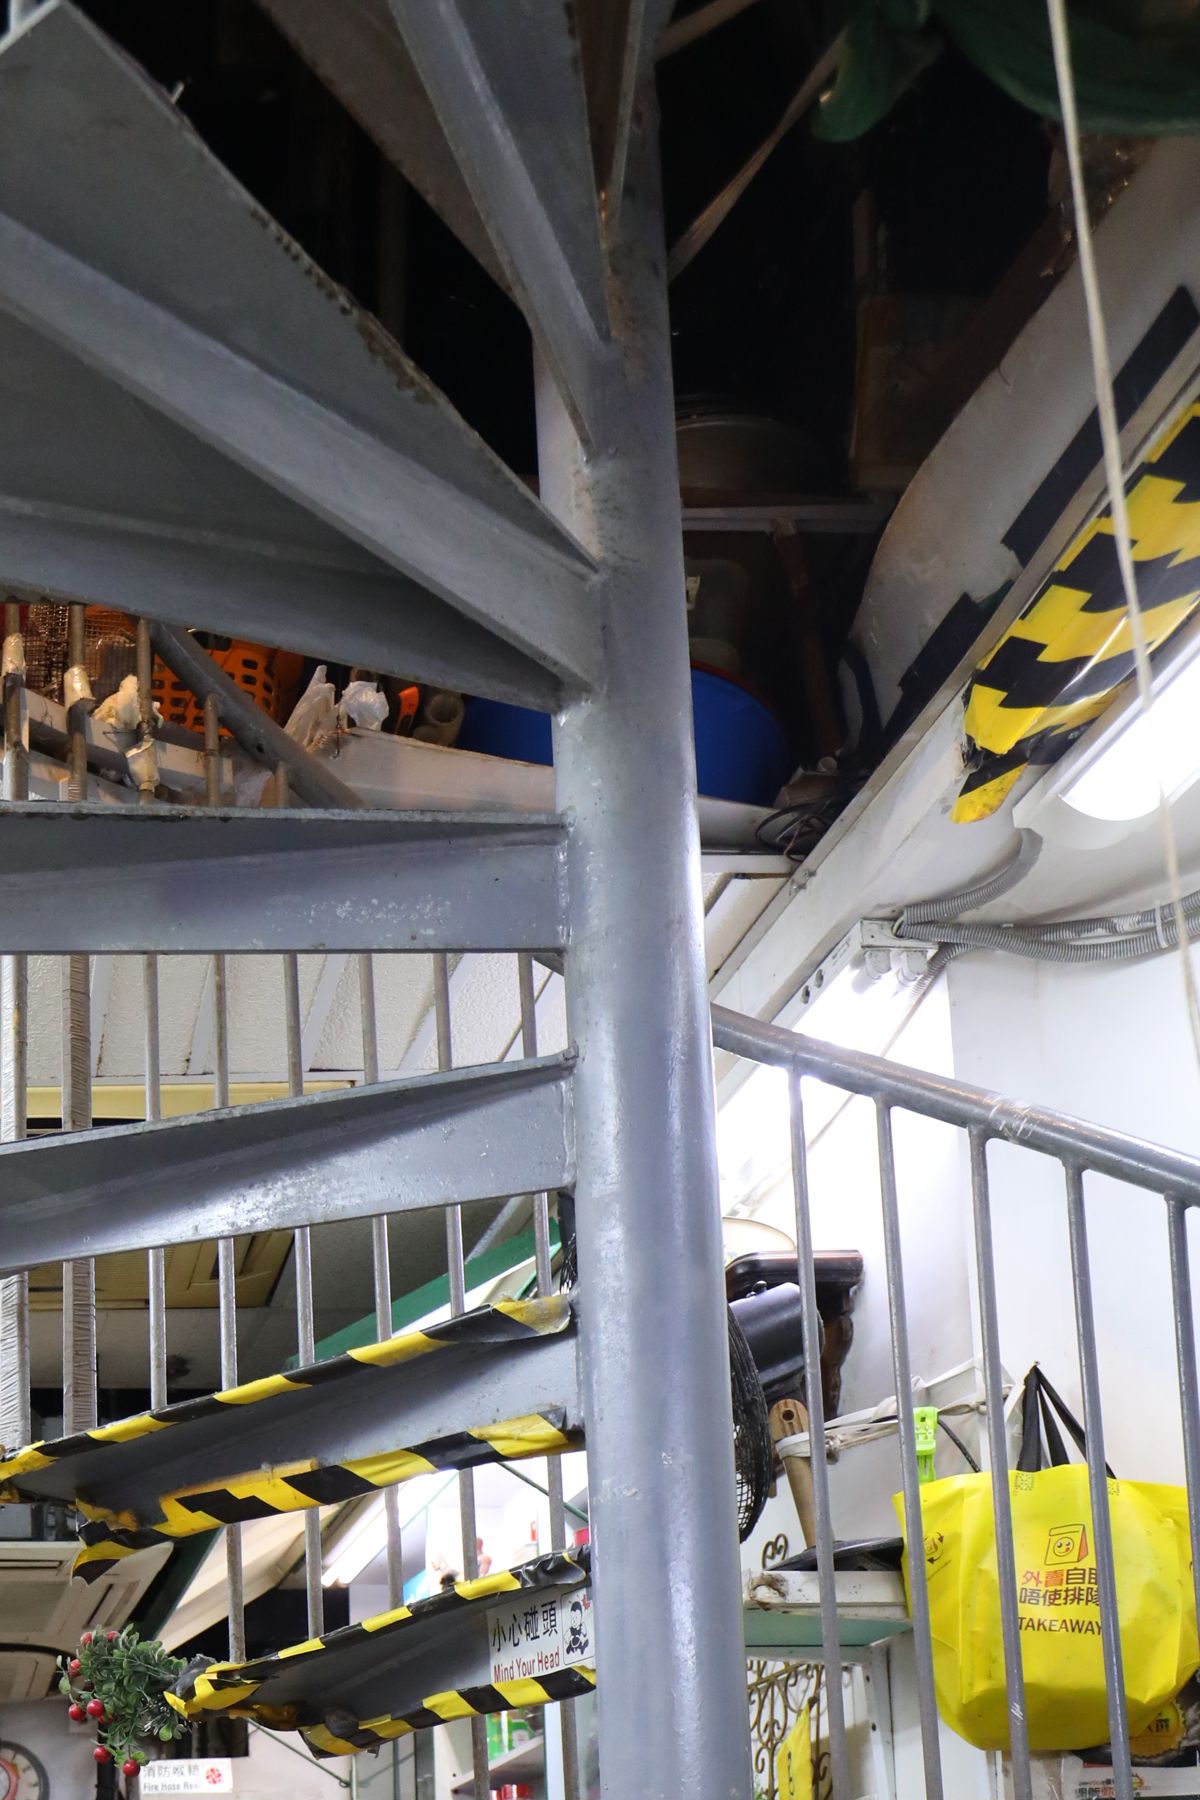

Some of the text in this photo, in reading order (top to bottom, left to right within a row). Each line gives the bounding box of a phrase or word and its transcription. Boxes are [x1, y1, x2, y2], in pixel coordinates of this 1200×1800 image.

[492, 1600, 557, 1652] 小心碰頭
[1018, 1616, 1103, 1635] TAKEAWAY
[494, 1646, 560, 1683] Mind Your Head
